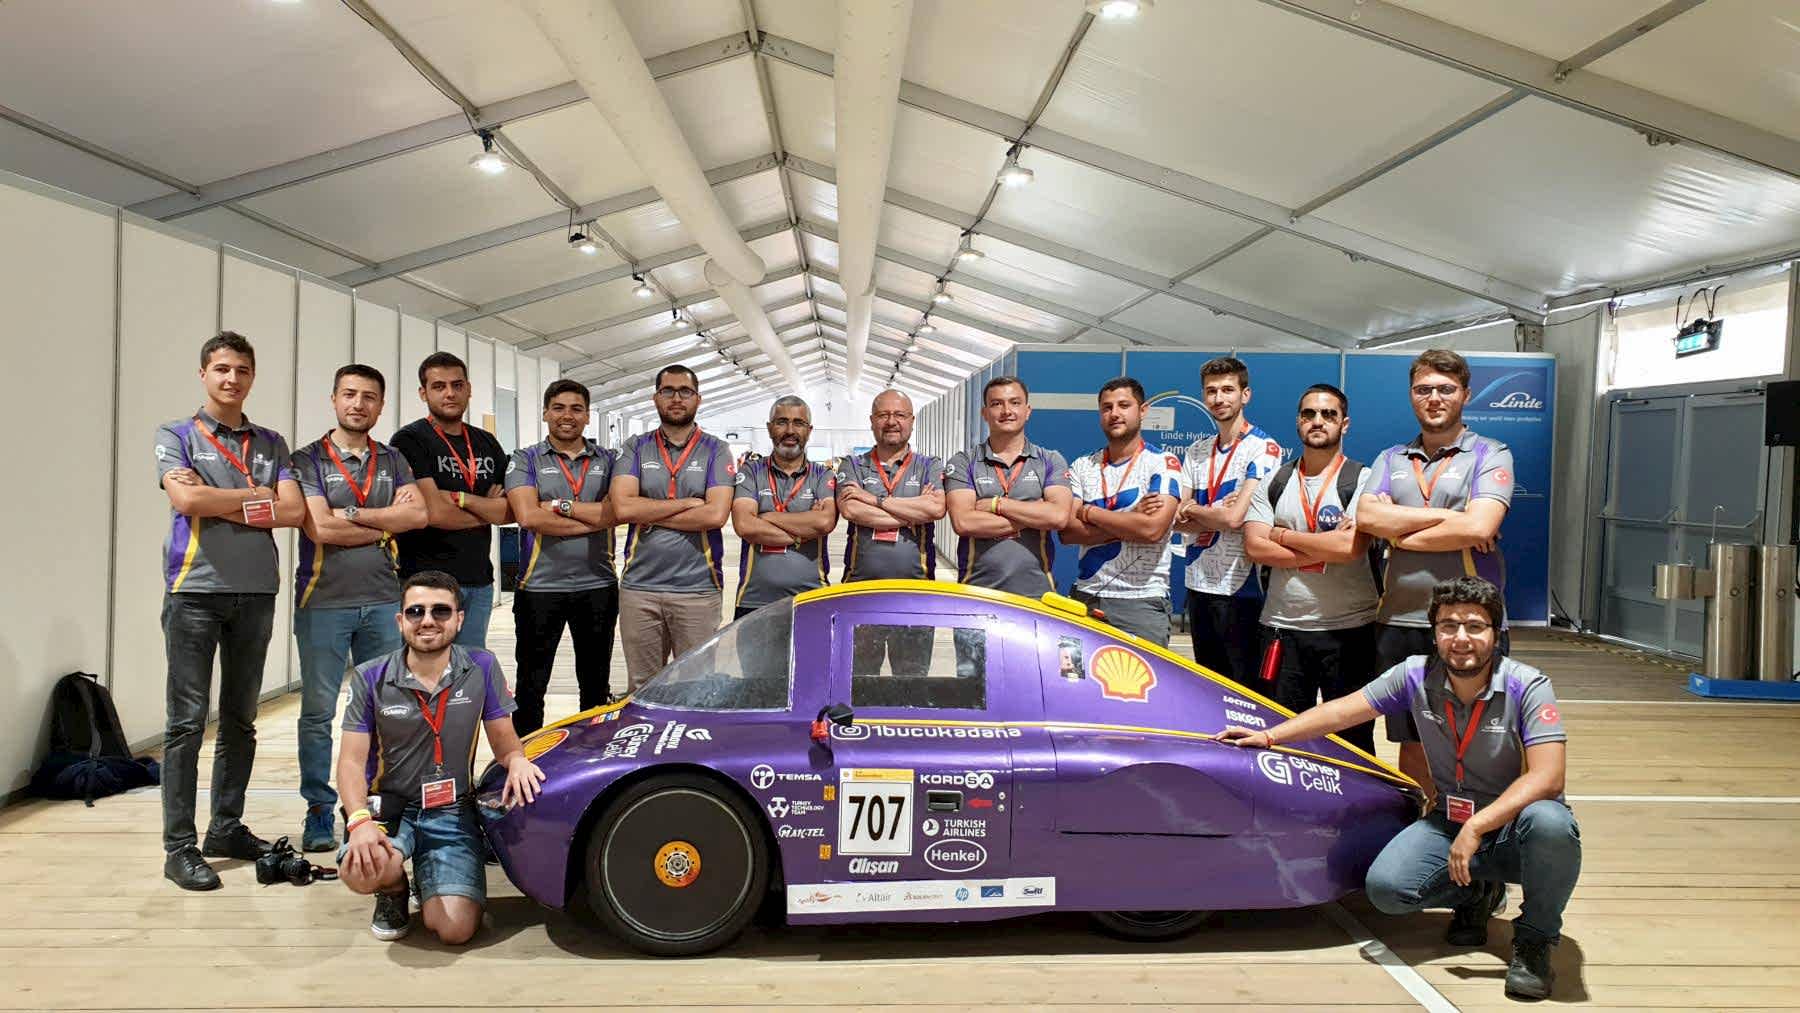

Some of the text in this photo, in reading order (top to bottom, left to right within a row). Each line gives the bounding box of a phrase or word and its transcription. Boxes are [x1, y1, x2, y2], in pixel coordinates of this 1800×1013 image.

[1488, 391, 1543, 409] Linde
[1160, 430, 1211, 442] Linde Hydro
[1289, 756, 1340, 781] Güney
[776, 773, 822, 781] TEMSA
[919, 772, 994, 789] KORDSA
[1300, 772, 1344, 796] Çelik
[848, 794, 906, 842] 707
[943, 819, 986, 828] TURKISH
[942, 828, 986, 837] AIRLINES
[931, 849, 980, 861] Henkel
